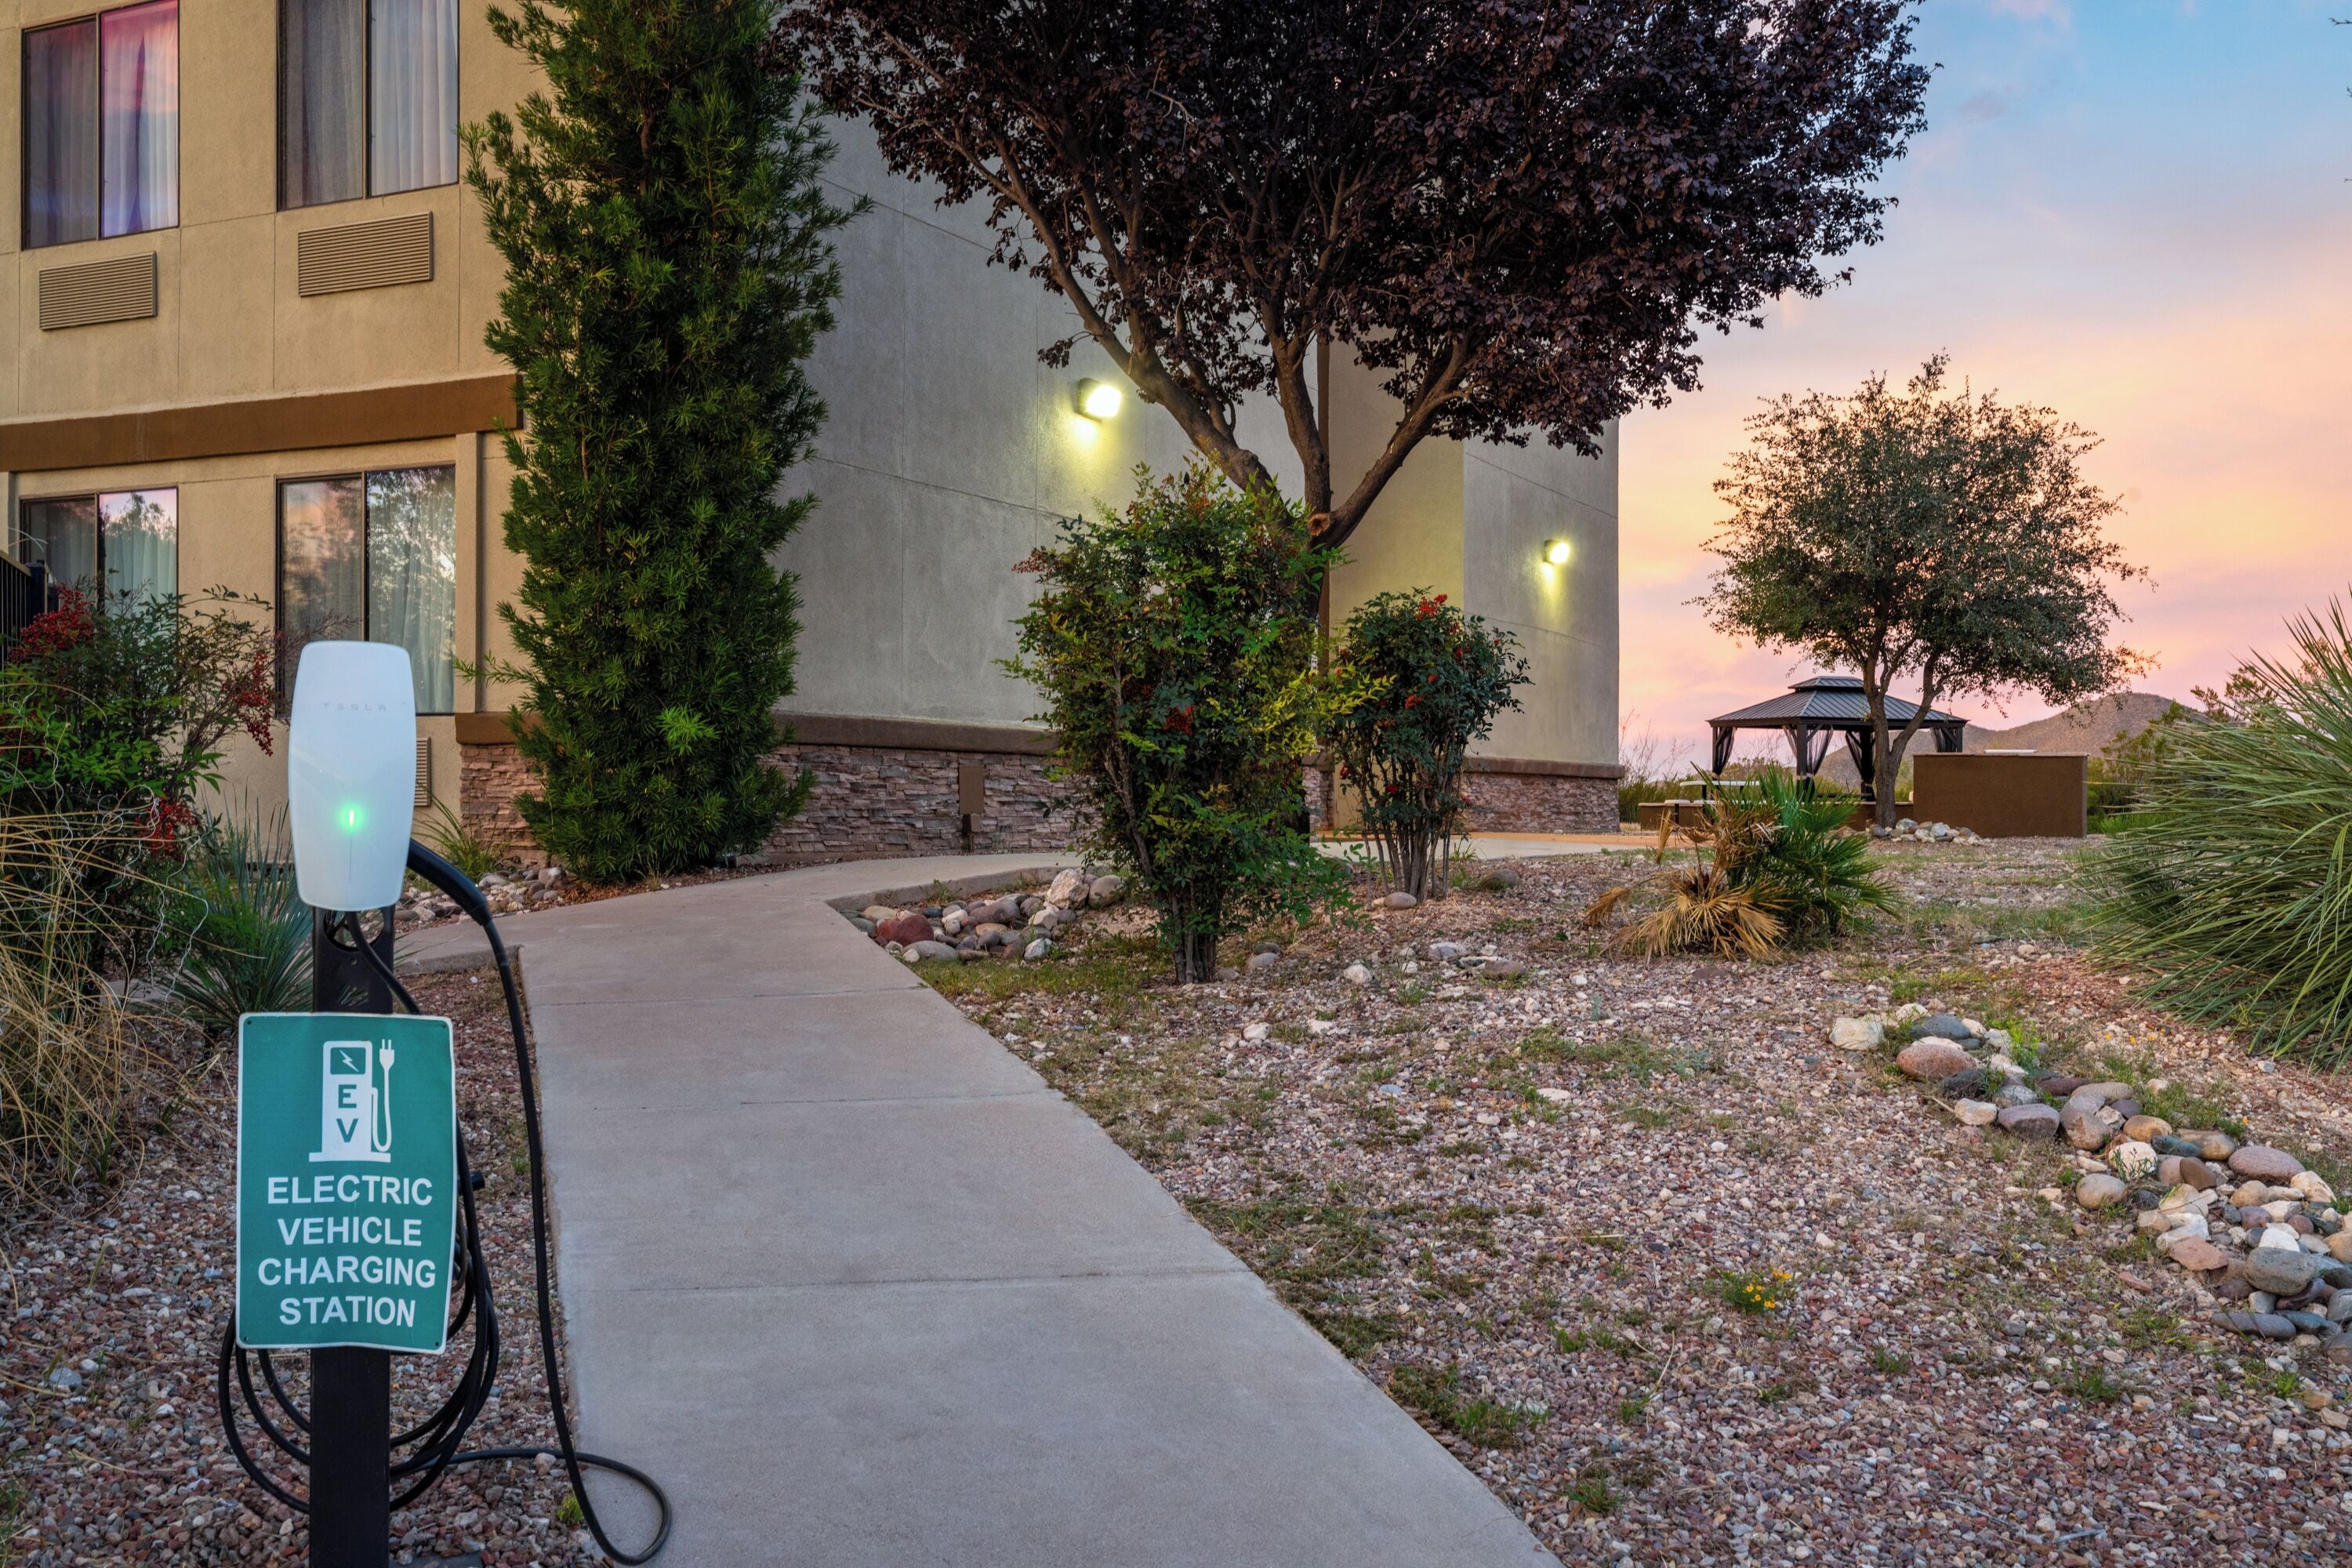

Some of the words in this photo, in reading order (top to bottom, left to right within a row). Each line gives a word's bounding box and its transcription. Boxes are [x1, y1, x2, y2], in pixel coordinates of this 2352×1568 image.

[336, 1083, 359, 1143] EV
[268, 1174, 433, 1206] ELECTRIC
[278, 1216, 422, 1247] VEHICLE
[258, 1255, 436, 1288] CHARGING
[279, 1296, 416, 1327] STATION
